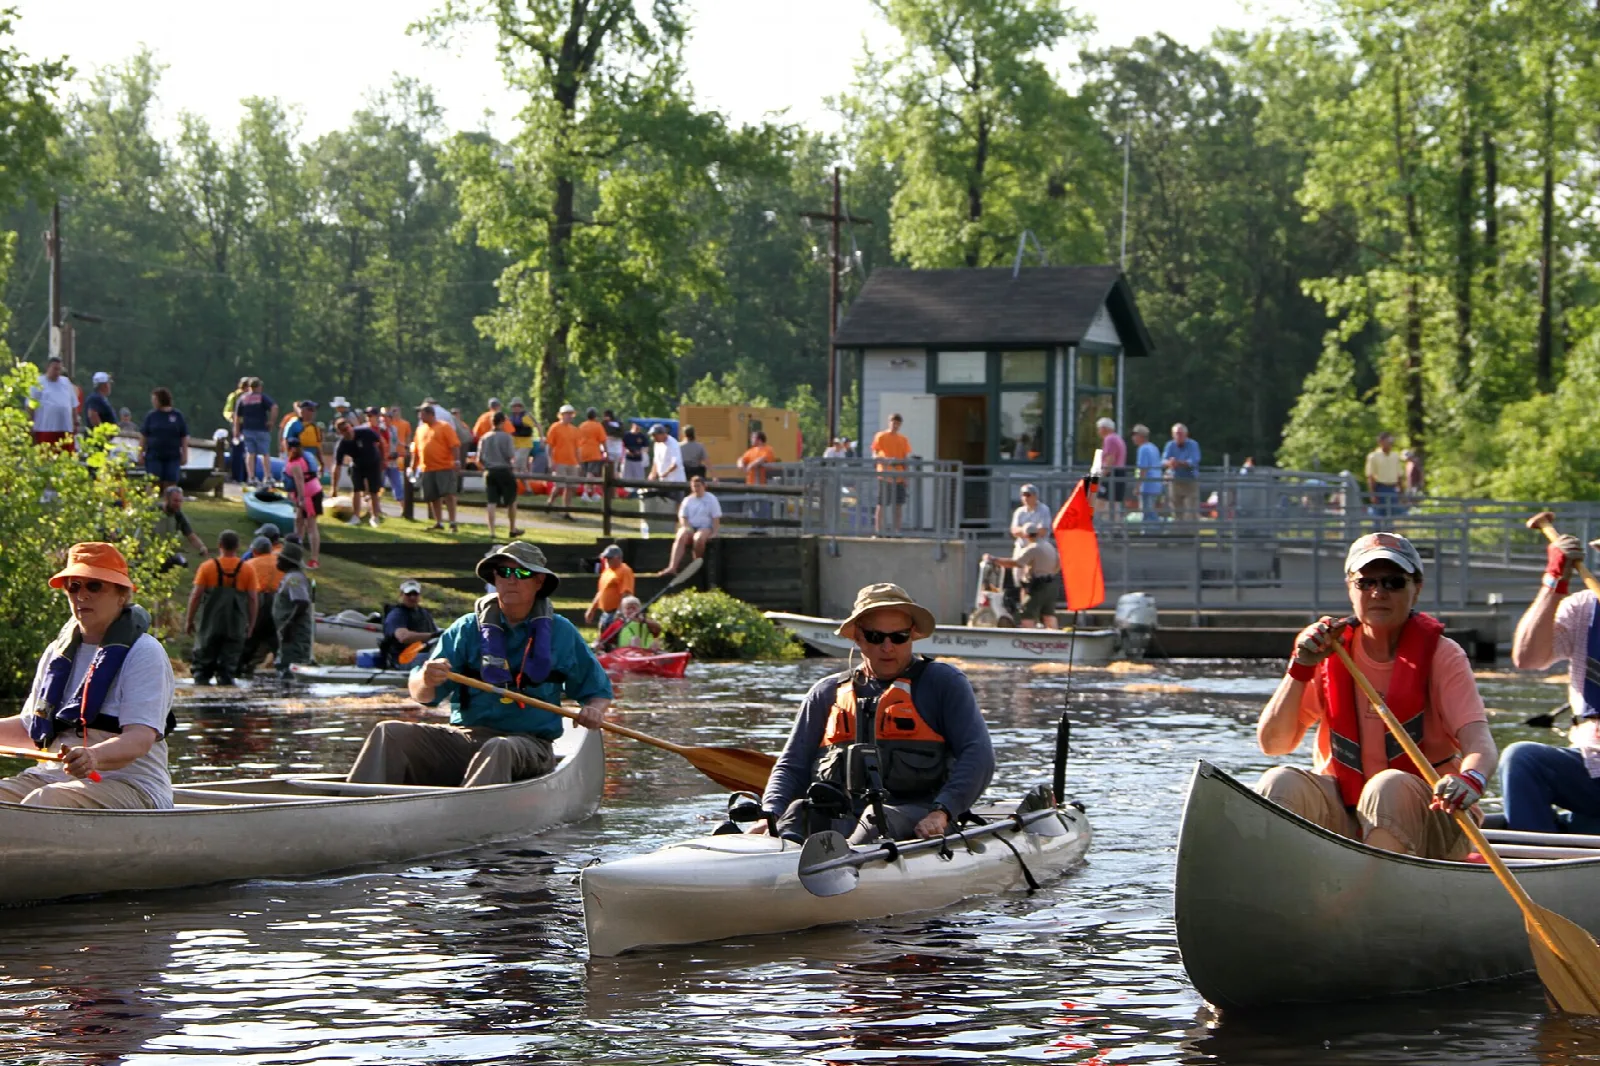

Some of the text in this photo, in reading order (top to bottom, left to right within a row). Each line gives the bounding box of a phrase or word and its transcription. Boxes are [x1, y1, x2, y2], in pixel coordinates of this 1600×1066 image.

[932, 634, 989, 649] Park Ranger
[1011, 638, 1070, 655] Chesapeake
